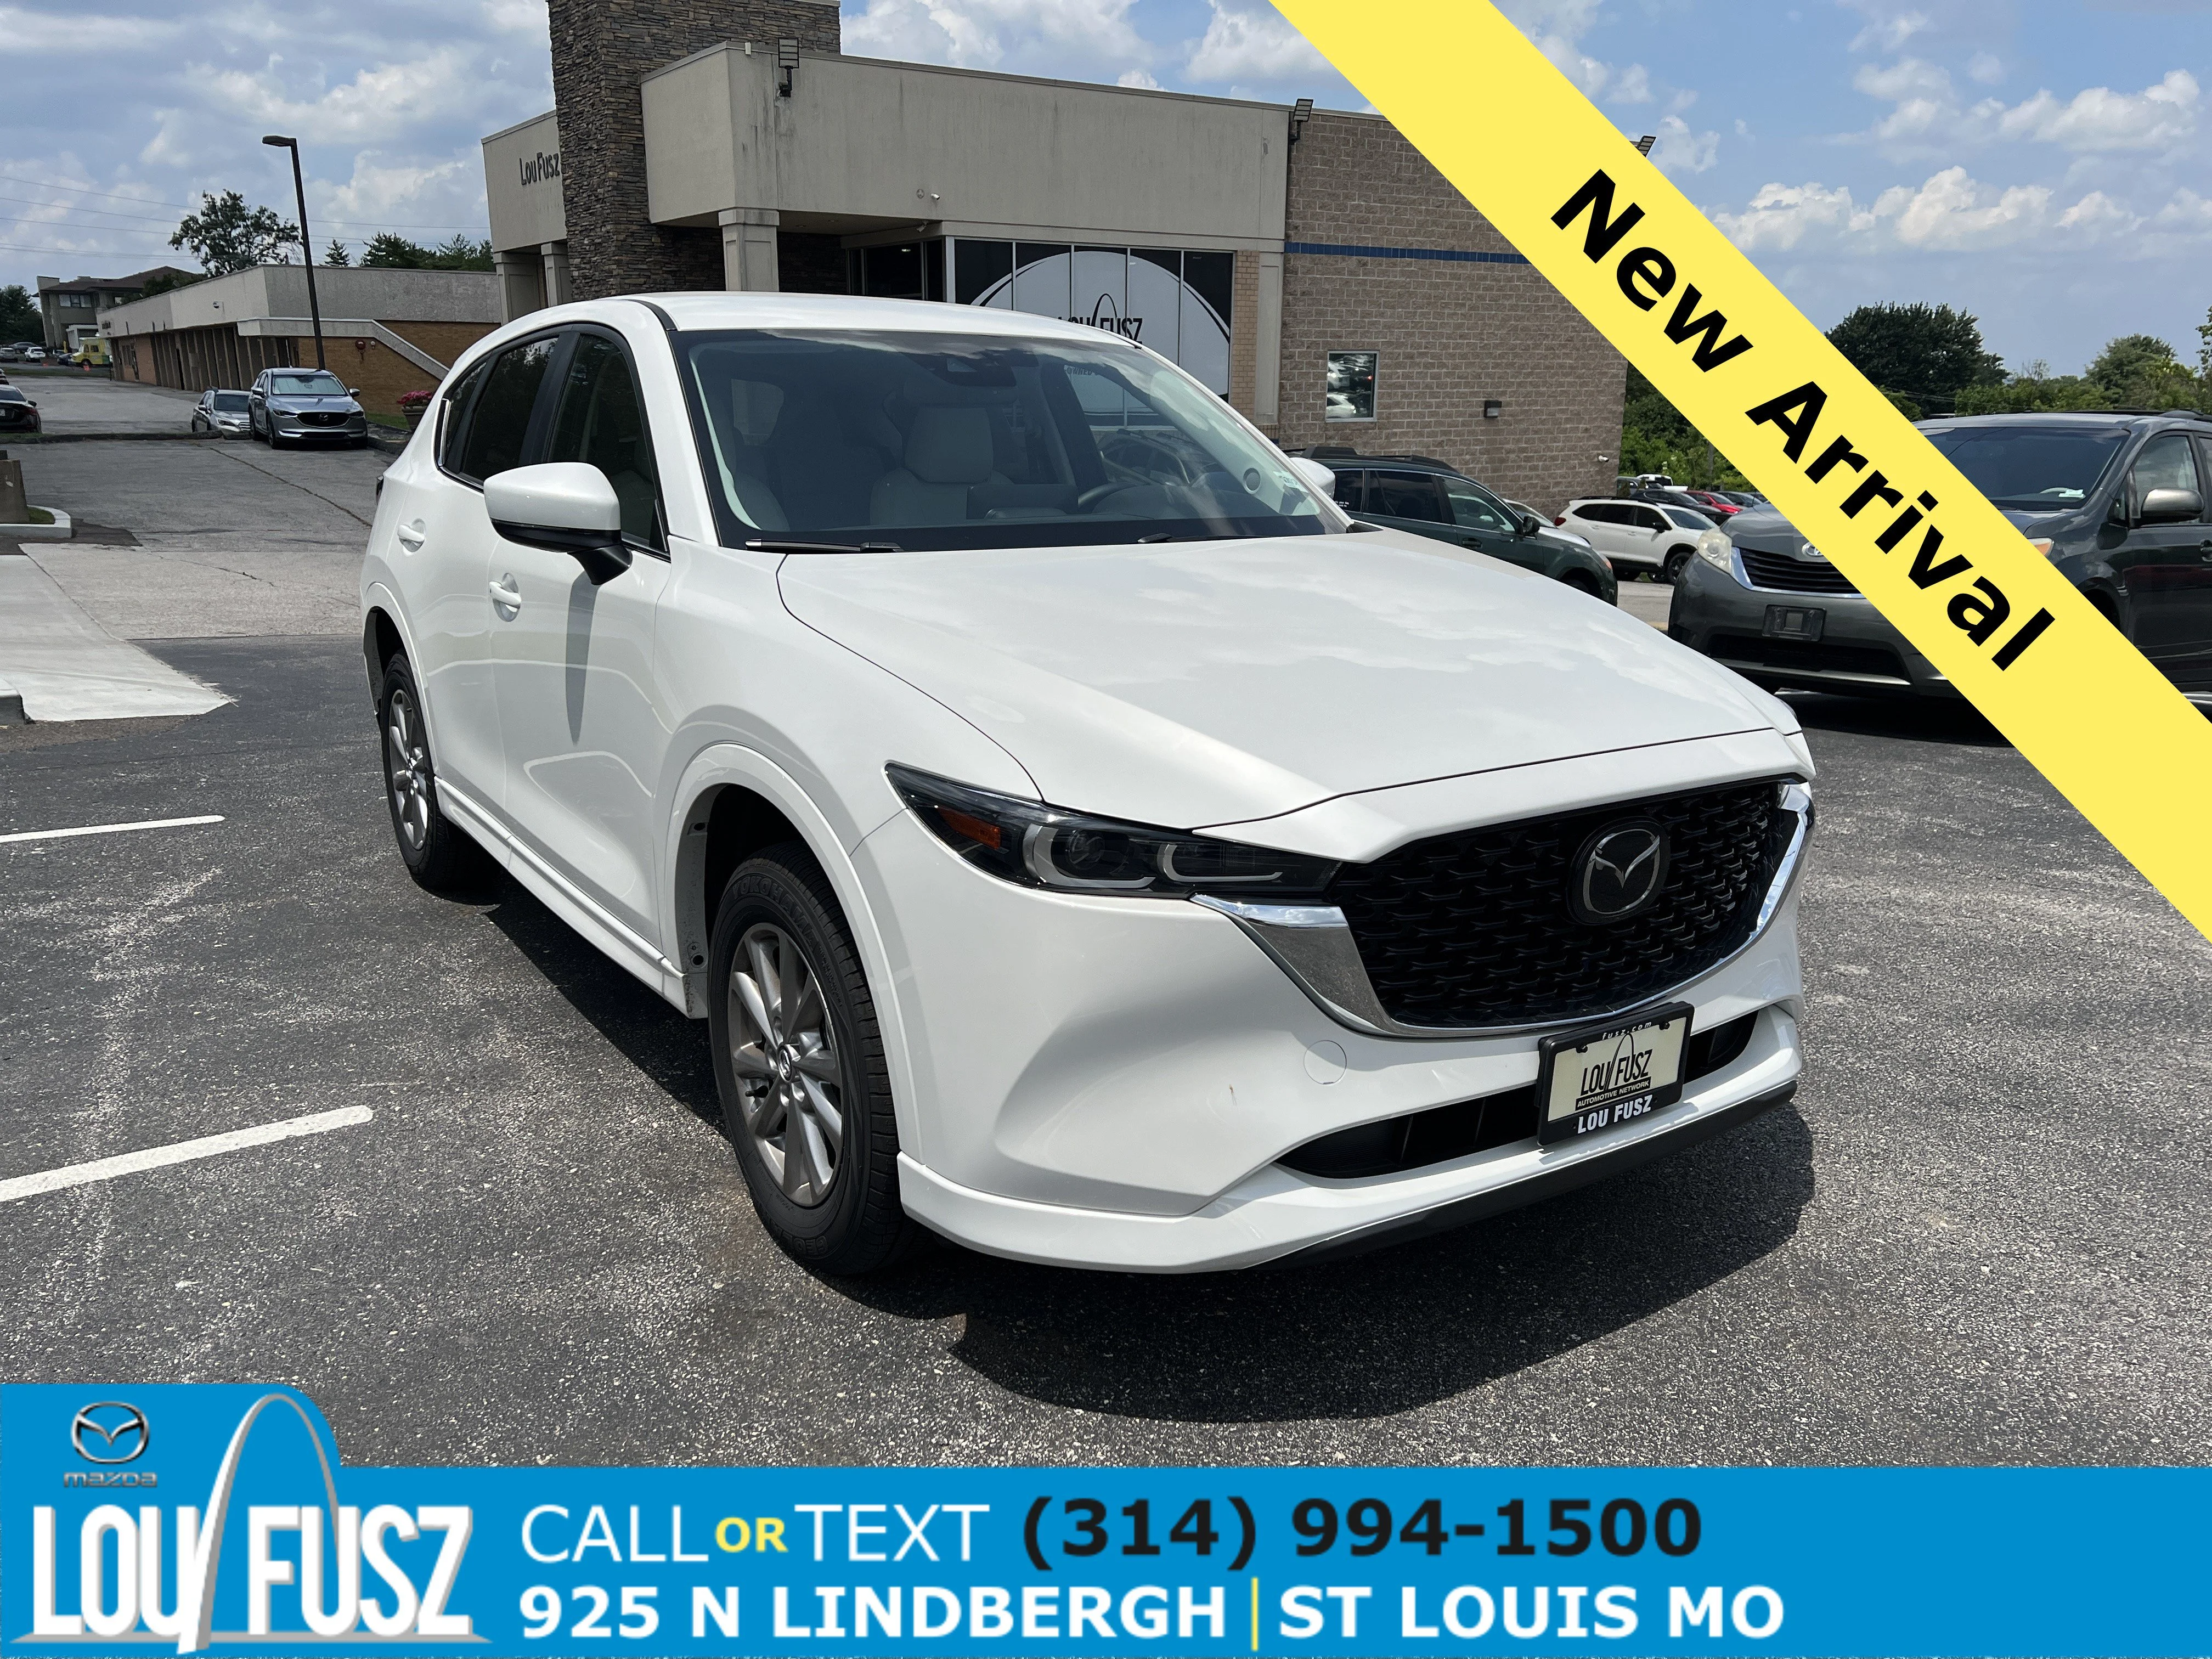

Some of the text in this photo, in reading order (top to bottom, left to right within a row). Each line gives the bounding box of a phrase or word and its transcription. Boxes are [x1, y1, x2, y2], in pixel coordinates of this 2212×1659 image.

[1602, 1022, 1652, 1040] fusz.com
[1581, 1049, 1653, 1097] LOU FUSZ
[1577, 1080, 1650, 1108] AUTOMOTIVE NETWORK
[1577, 1094, 1653, 1134] LOU FUSZ
